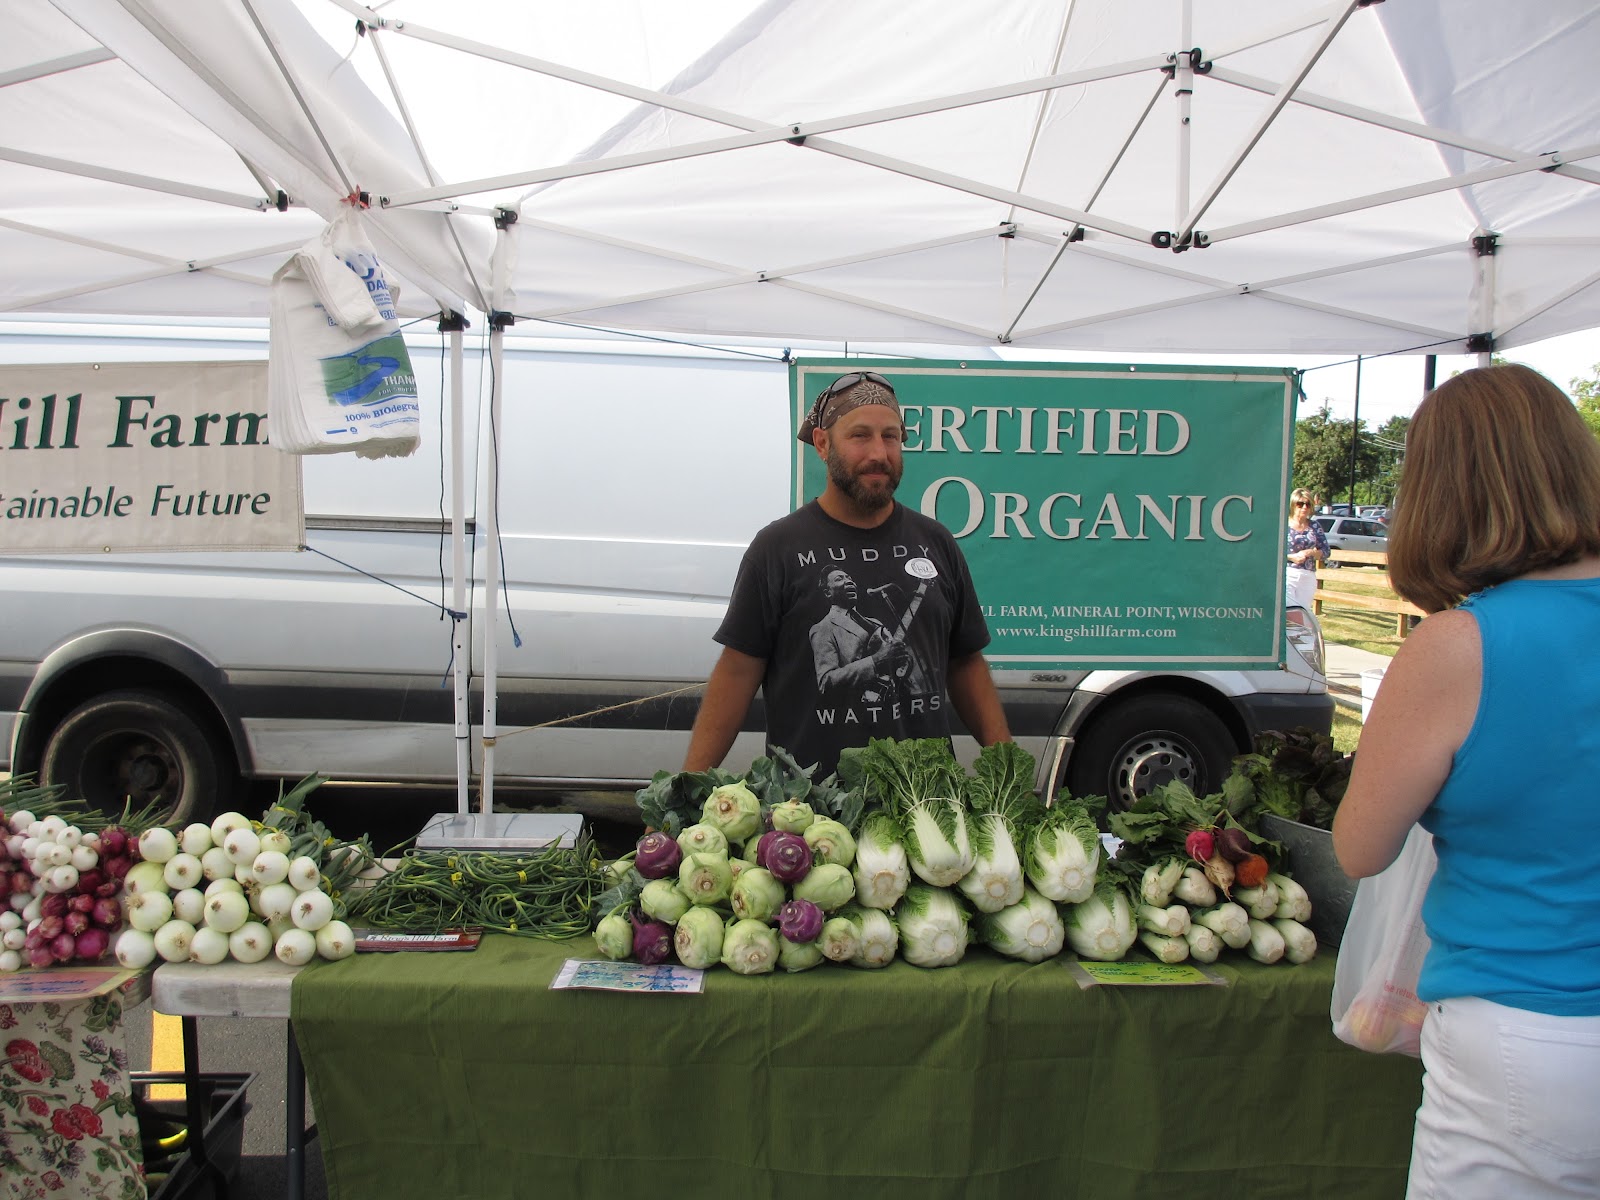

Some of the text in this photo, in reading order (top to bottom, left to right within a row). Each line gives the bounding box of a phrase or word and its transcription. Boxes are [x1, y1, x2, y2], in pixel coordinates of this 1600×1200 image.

[107, 396, 269, 448] Farm
[345, 412, 371, 422] 100%
[899, 405, 1190, 456] ERTIFIED
[151, 485, 271, 516] Future
[920, 476, 1253, 541] ORGANIC
[797, 545, 929, 567] MUDDY
[981, 605, 1263, 620] LL FARM, MINERAL POINT, WISCONSIN
[996, 624, 1177, 641] www.kingshillfarm.com
[816, 696, 941, 725] WATERS
